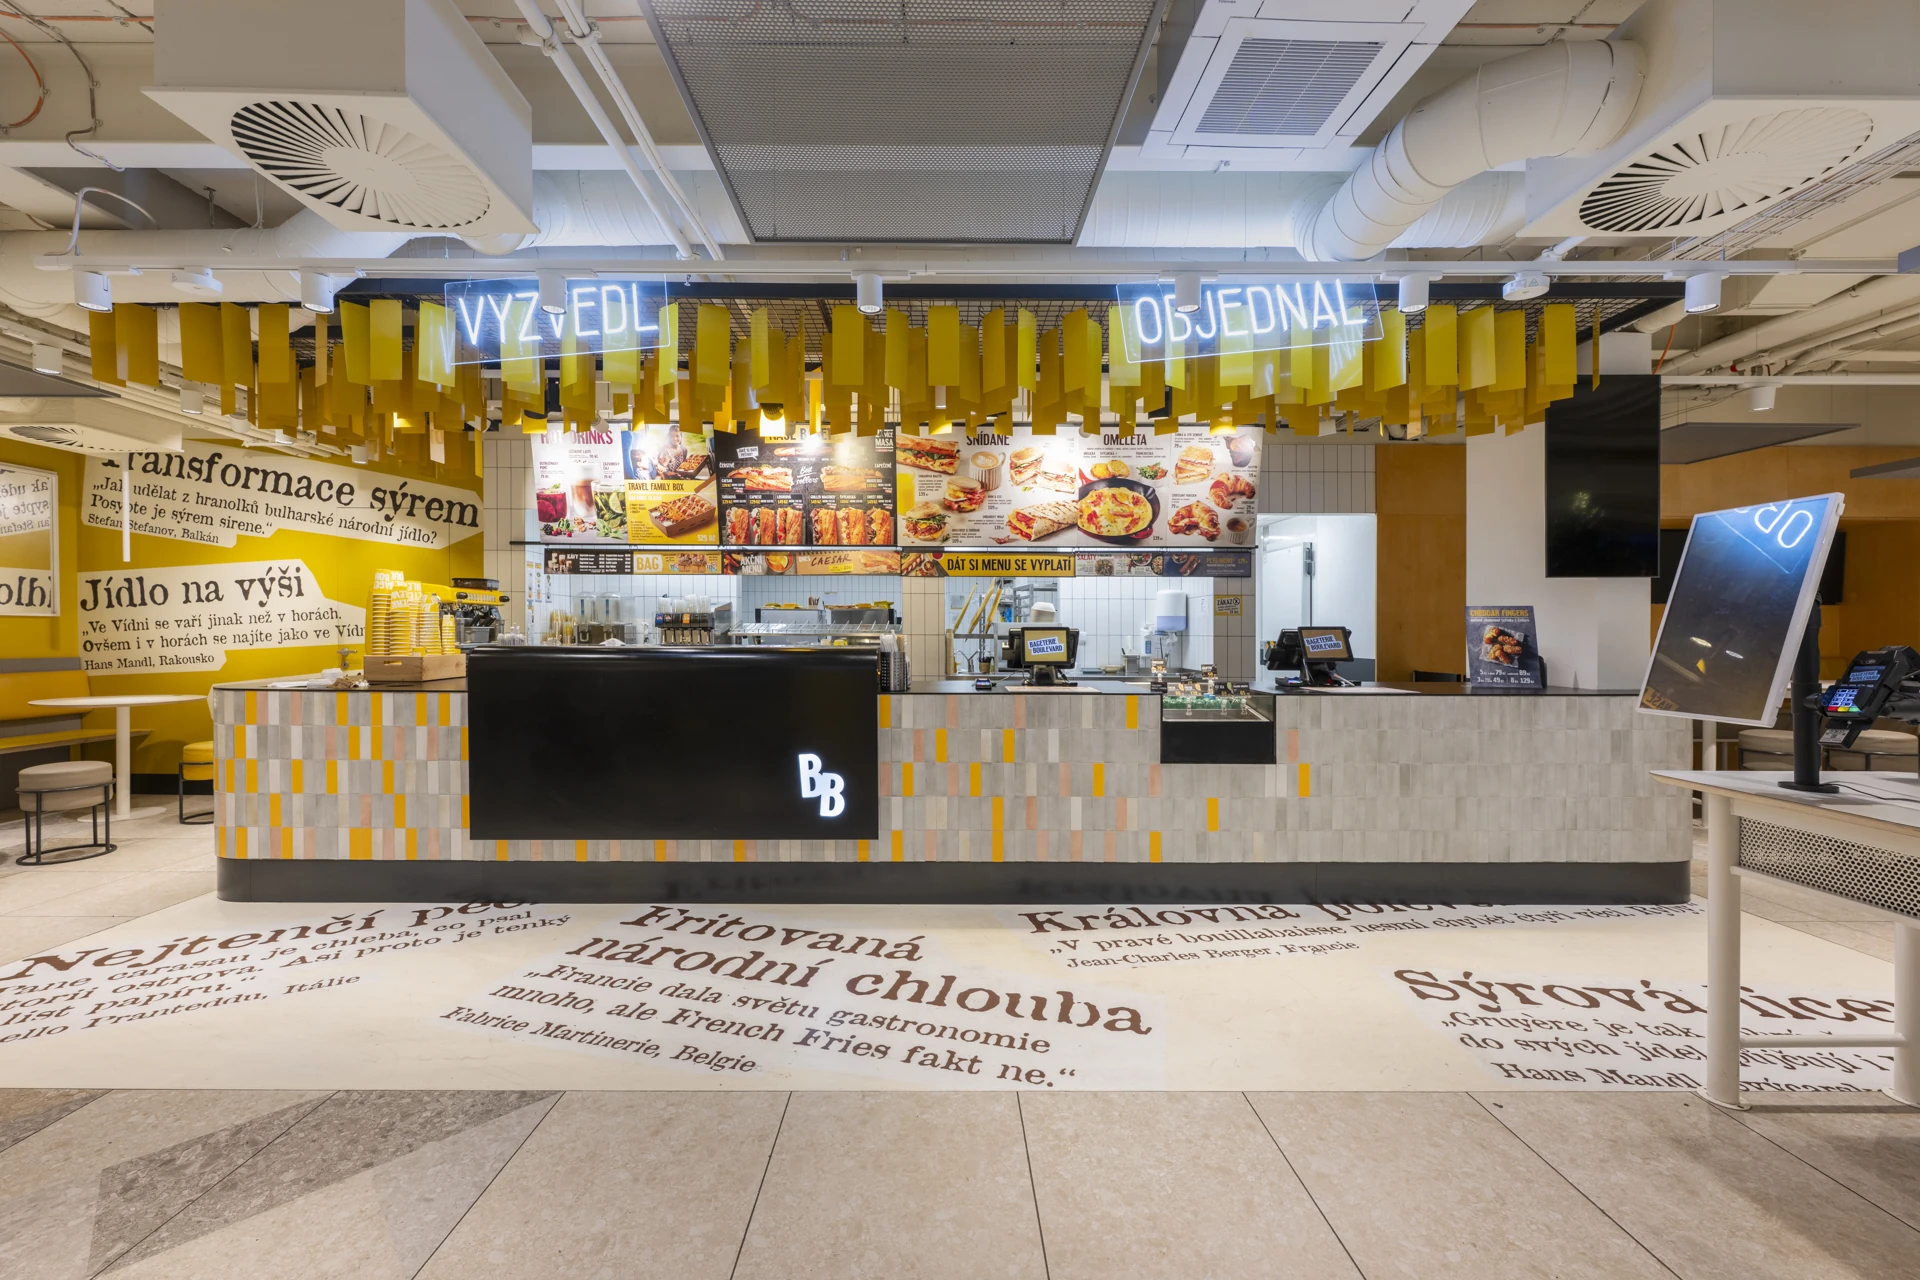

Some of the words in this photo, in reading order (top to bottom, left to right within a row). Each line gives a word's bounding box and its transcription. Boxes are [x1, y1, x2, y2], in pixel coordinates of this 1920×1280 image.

[875, 438, 894, 447] MASA
[628, 482, 648, 491] TRAVEL
[651, 482, 671, 491] FAMILY
[673, 482, 685, 491] BOX
[92, 494, 148, 516] Posyte
[152, 504, 166, 521] je
[172, 507, 214, 527] sýrem
[219, 515, 272, 535] sirene.“
[134, 483, 177, 502] udělat
[183, 492, 191, 503] z
[195, 492, 260, 515] hranolků
[264, 503, 334, 527] bulharské
[338, 517, 393, 537] národní
[397, 525, 438, 544] jídlo?
[370, 481, 479, 527] sýrem
[88, 513, 124, 530] Stefan
[128, 517, 178, 538] Stefanov,
[182, 529, 220, 545] Balkán
[636, 556, 660, 572] BAG
[740, 554, 763, 566] AKČNÍ
[742, 564, 763, 574] MENU
[811, 553, 853, 567] CAESAR
[947, 556, 966, 571] DÁT
[969, 557, 979, 571] SI
[981, 558, 1012, 571] MENU
[1014, 558, 1028, 571] SE
[1030, 556, 1072, 572] VYPLATÍ
[80, 575, 169, 612] Jídlo
[182, 580, 225, 605] na
[235, 565, 305, 608] výši
[1216, 598, 1233, 606] ZÁKAZ
[83, 620, 107, 637] „Ve
[112, 617, 150, 633] Vídni
[155, 619, 170, 630] se
[174, 614, 202, 629] vaří
[207, 612, 243, 630] jinak
[249, 610, 273, 624] než
[277, 613, 286, 623] v
[291, 607, 342, 622] horách.
[1470, 609, 1500, 617] CHEDDAR
[1502, 609, 1529, 617] FINGERS
[83, 638, 131, 652] Ovšem
[136, 636, 141, 650] i
[147, 639, 155, 649] v
[160, 633, 208, 648] horách
[213, 634, 228, 645] se
[232, 629, 273, 646] najíte
[278, 628, 309, 645] jako
[314, 629, 331, 639] ve
[1029, 637, 1058, 648] BAGETERIE
[1032, 644, 1063, 654] BOULEVARD
[1306, 635, 1334, 646] BAGETERIE
[1310, 641, 1342, 651] BOULEVARD
[84, 659, 113, 671] Hans
[117, 656, 156, 669] Mandl,
[159, 652, 215, 667] Rakousko
[619, 904, 926, 962] Fritovaná
[1017, 904, 1301, 934] Královna
[1092, 933, 1173, 952] pravé
[1175, 919, 1347, 944] bouillabaisse
[1351, 918, 1429, 934] nesmí
[1432, 912, 1515, 930] chybět
[0, 909, 386, 983] Nejtenčí
[107, 953, 249, 987] carasau
[261, 946, 297, 961] je
[310, 931, 419, 952] chleba,
[434, 922, 466, 932] co
[477, 910, 532, 928] psal
[111, 966, 264, 995] ostrova.
[279, 950, 342, 968] Asi
[355, 937, 442, 959] proto
[451, 934, 482, 944] je
[494, 915, 572, 939] tenký
[1066, 950, 1201, 969] Jean-Charles
[1201, 944, 1281, 964] Berger,
[1281, 938, 1360, 956] Francie
[564, 936, 835, 988] národní
[845, 970, 1153, 1036] chlouba
[1393, 969, 1708, 1014] Sýrová
[81, 991, 268, 1030] Pranteddu,
[282, 975, 361, 995] Itálie
[522, 964, 653, 994] „Francie
[659, 982, 721, 1004] dala
[732, 996, 820, 1019] světu
[826, 1009, 1051, 1054] gastronomie
[439, 1005, 530, 1036] Fabrice
[529, 1020, 661, 1064] Martinerie,
[669, 1044, 757, 1072] Belgie
[488, 985, 599, 1015] mnoho,
[606, 1001, 658, 1021] ale
[661, 1007, 785, 1042] French
[793, 1027, 891, 1059] Fries
[901, 1045, 983, 1076] fakt
[997, 1064, 1076, 1088] ne.“
[1441, 1011, 1589, 1033] „Gruyère
[1592, 1018, 1633, 1037] je
[1634, 1021, 1707, 1039] tak
[1458, 1033, 1504, 1050] do
[1513, 1037, 1623, 1057] svých
[1489, 1062, 1587, 1083] Hans
